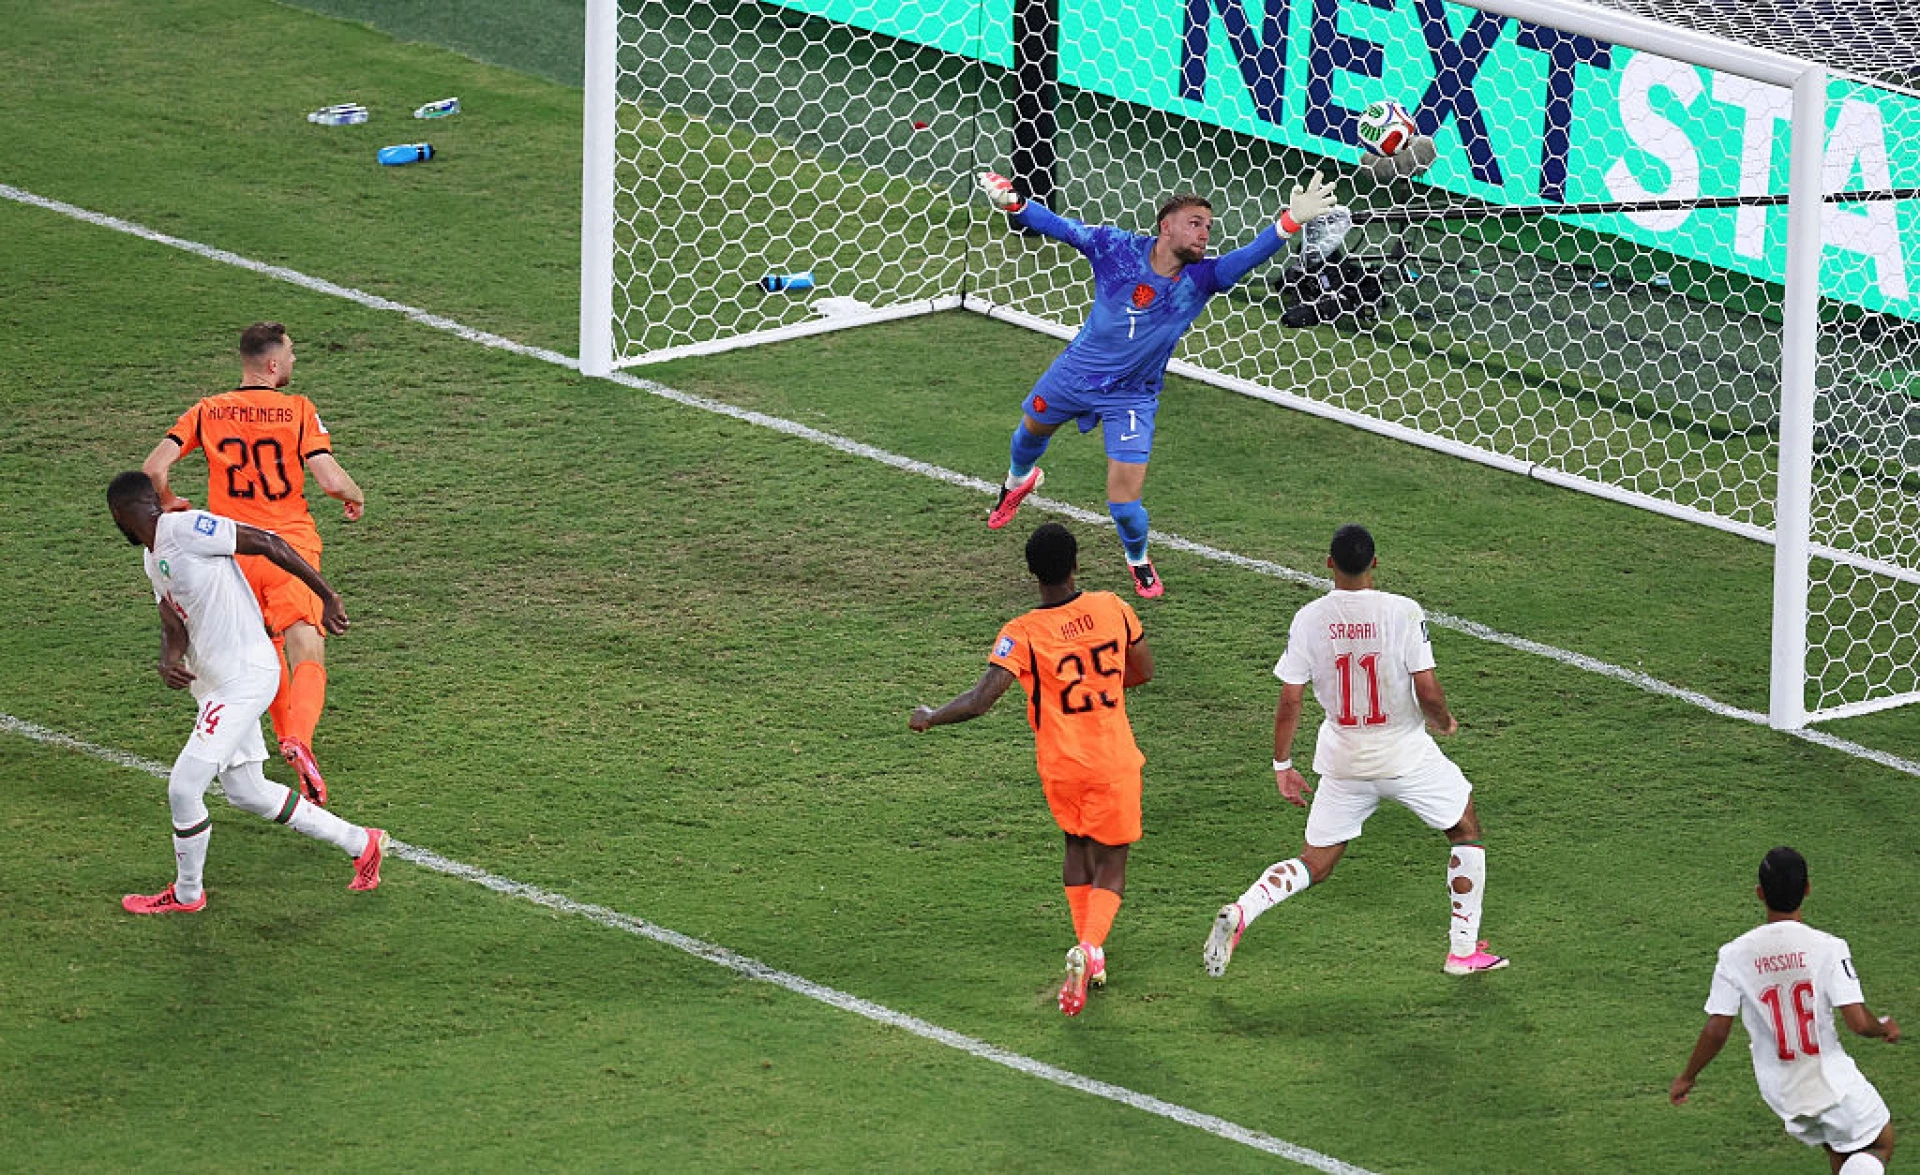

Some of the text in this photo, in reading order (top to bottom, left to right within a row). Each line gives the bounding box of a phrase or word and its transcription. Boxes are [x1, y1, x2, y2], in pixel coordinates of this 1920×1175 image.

[1128, 316, 1136, 340] 1
[1127, 410, 1137, 432] 1
[218, 437, 292, 501] 20
[1061, 614, 1094, 639] HATO
[1057, 640, 1121, 714] 25
[1335, 652, 1388, 728] 11
[197, 701, 225, 735] 14
[1754, 951, 1808, 975] YASSINE
[1759, 980, 1820, 1061] 16
